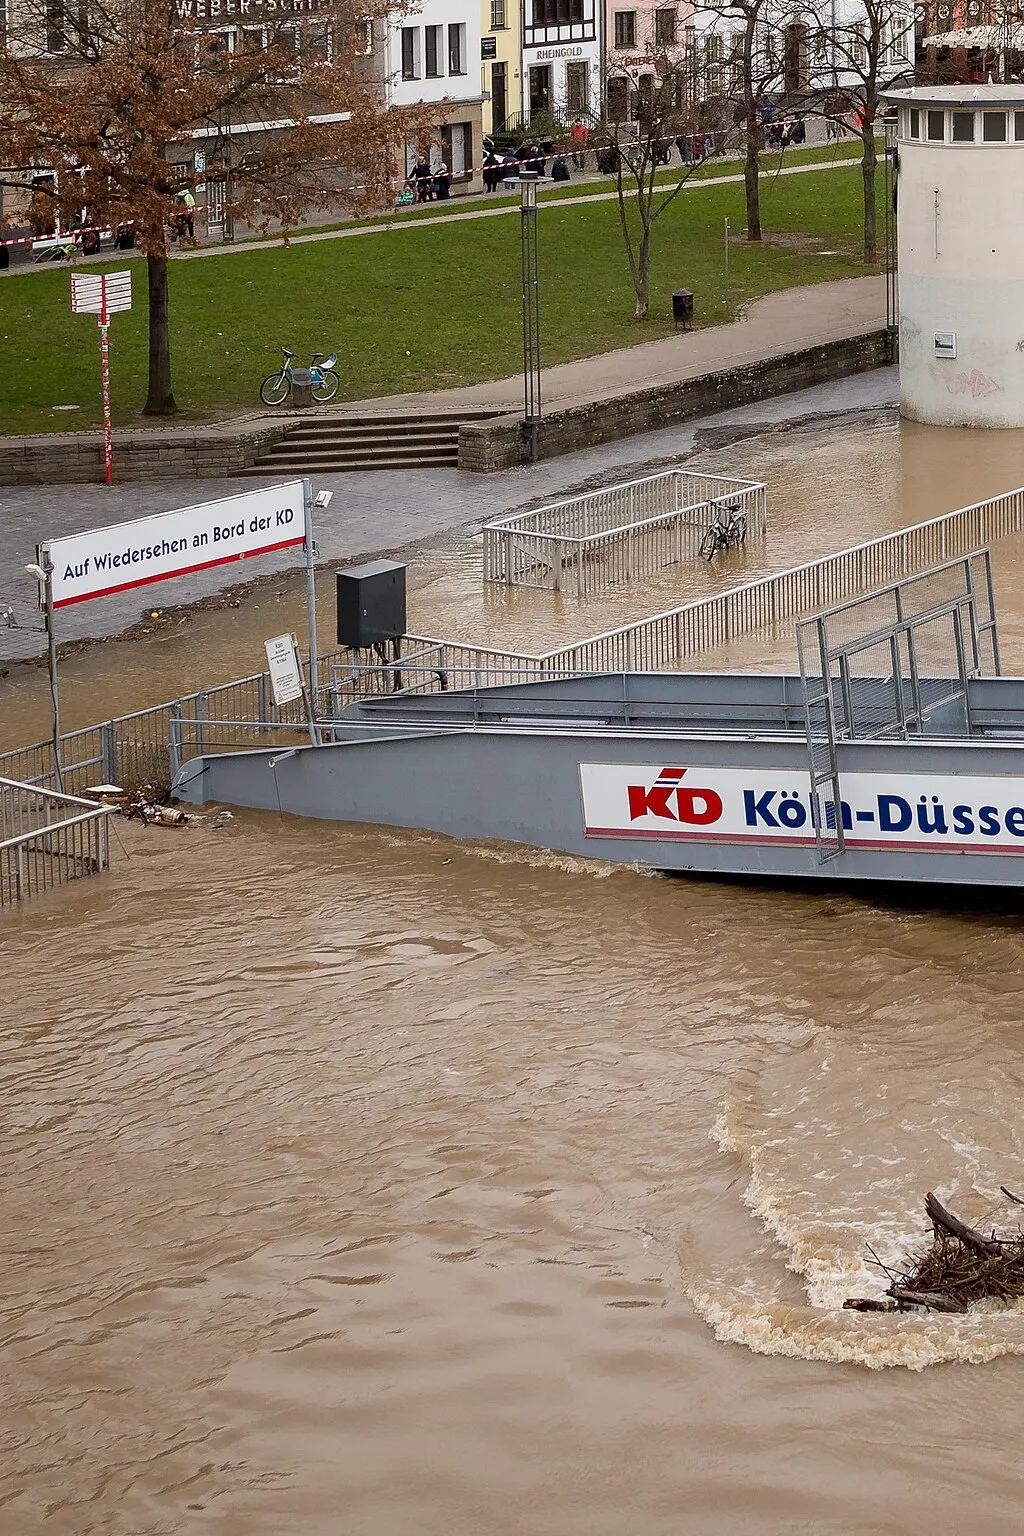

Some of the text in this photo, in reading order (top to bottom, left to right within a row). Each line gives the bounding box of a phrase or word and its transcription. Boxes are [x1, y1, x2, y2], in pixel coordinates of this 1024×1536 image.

[536, 47, 582, 60] RHEINGOLD
[63, 508, 294, 581] Auf Wiedersehen an Bord der KD
[627, 768, 724, 826] KD
